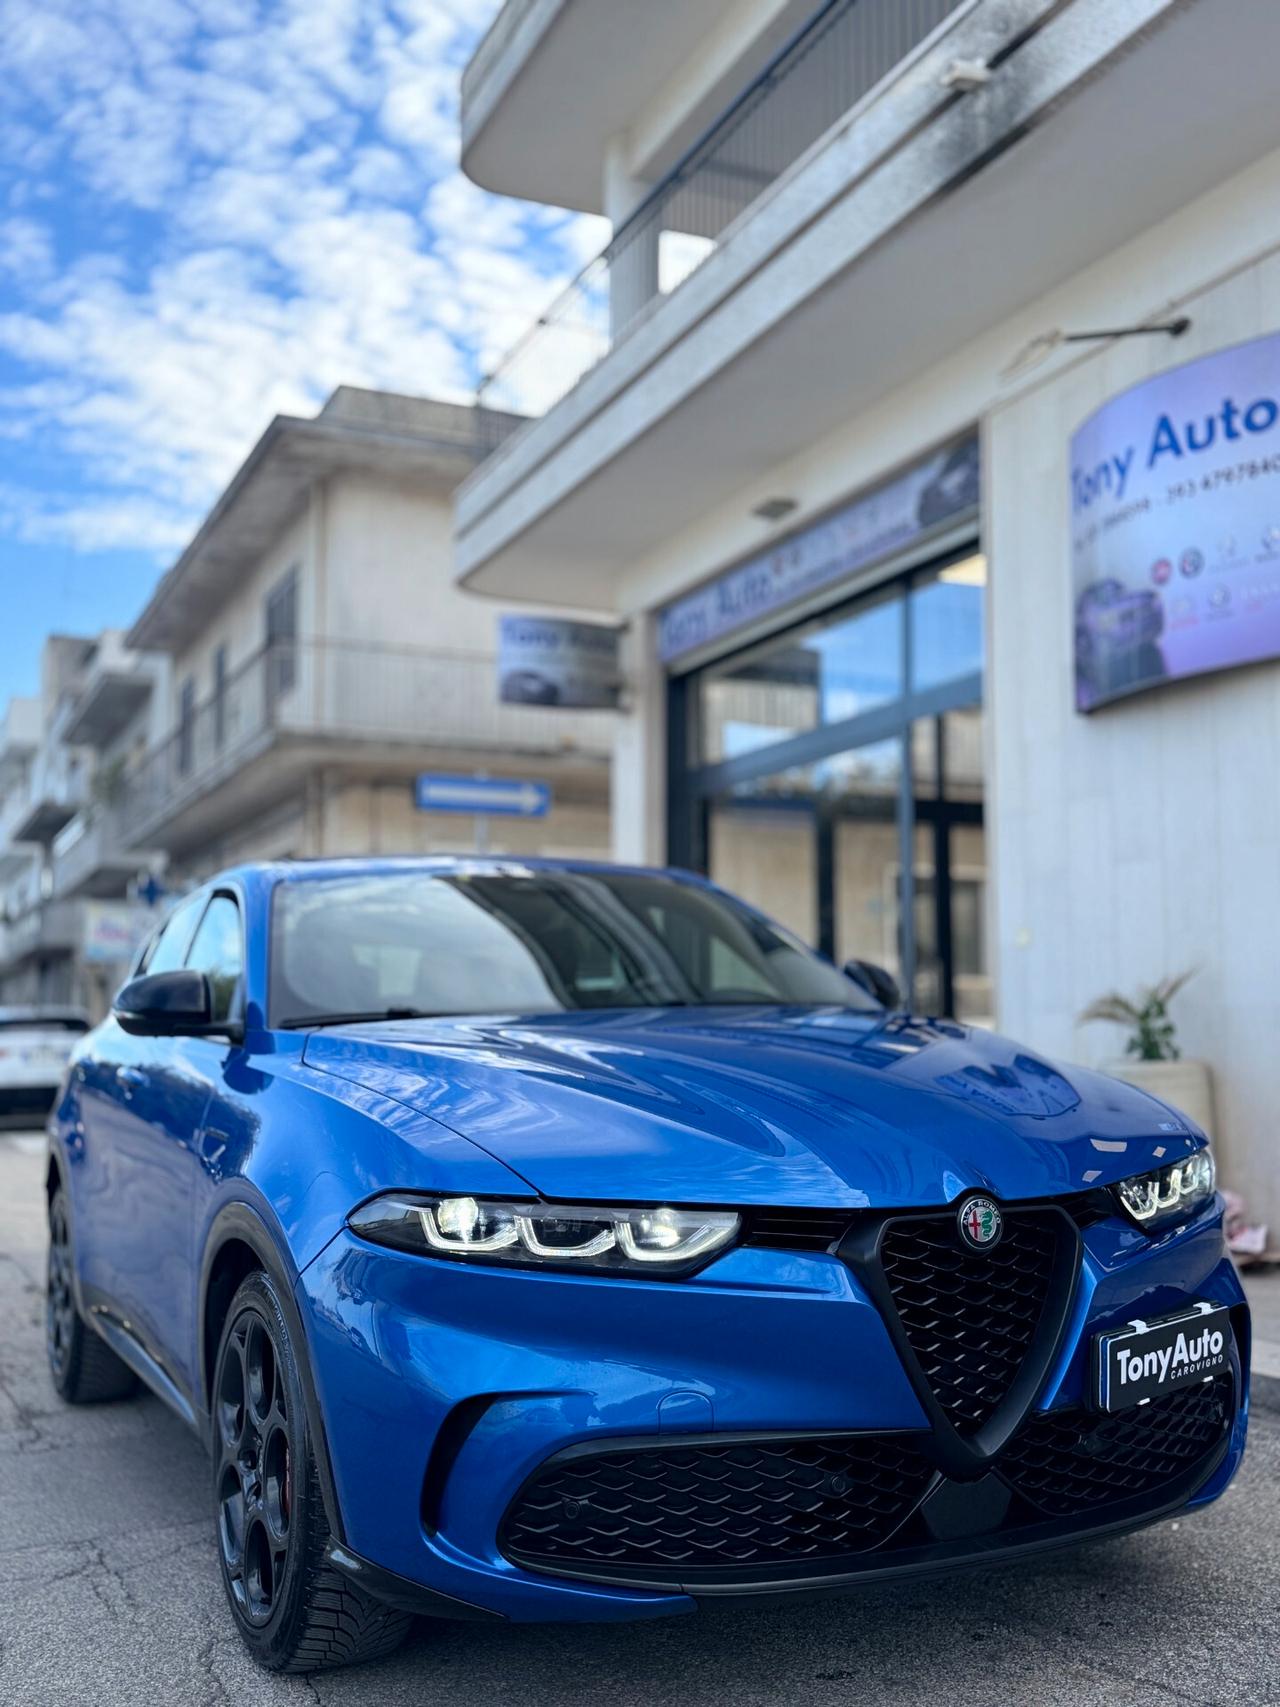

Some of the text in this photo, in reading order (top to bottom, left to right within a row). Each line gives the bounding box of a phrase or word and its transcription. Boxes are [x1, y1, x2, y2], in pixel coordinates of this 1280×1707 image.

[1147, 396, 1279, 468] Auto
[963, 1200, 1001, 1226] ALFA ROMEO
[1117, 1328, 1223, 1385] TonyAuto
[1170, 1354, 1224, 1380] CAROVIGNO
